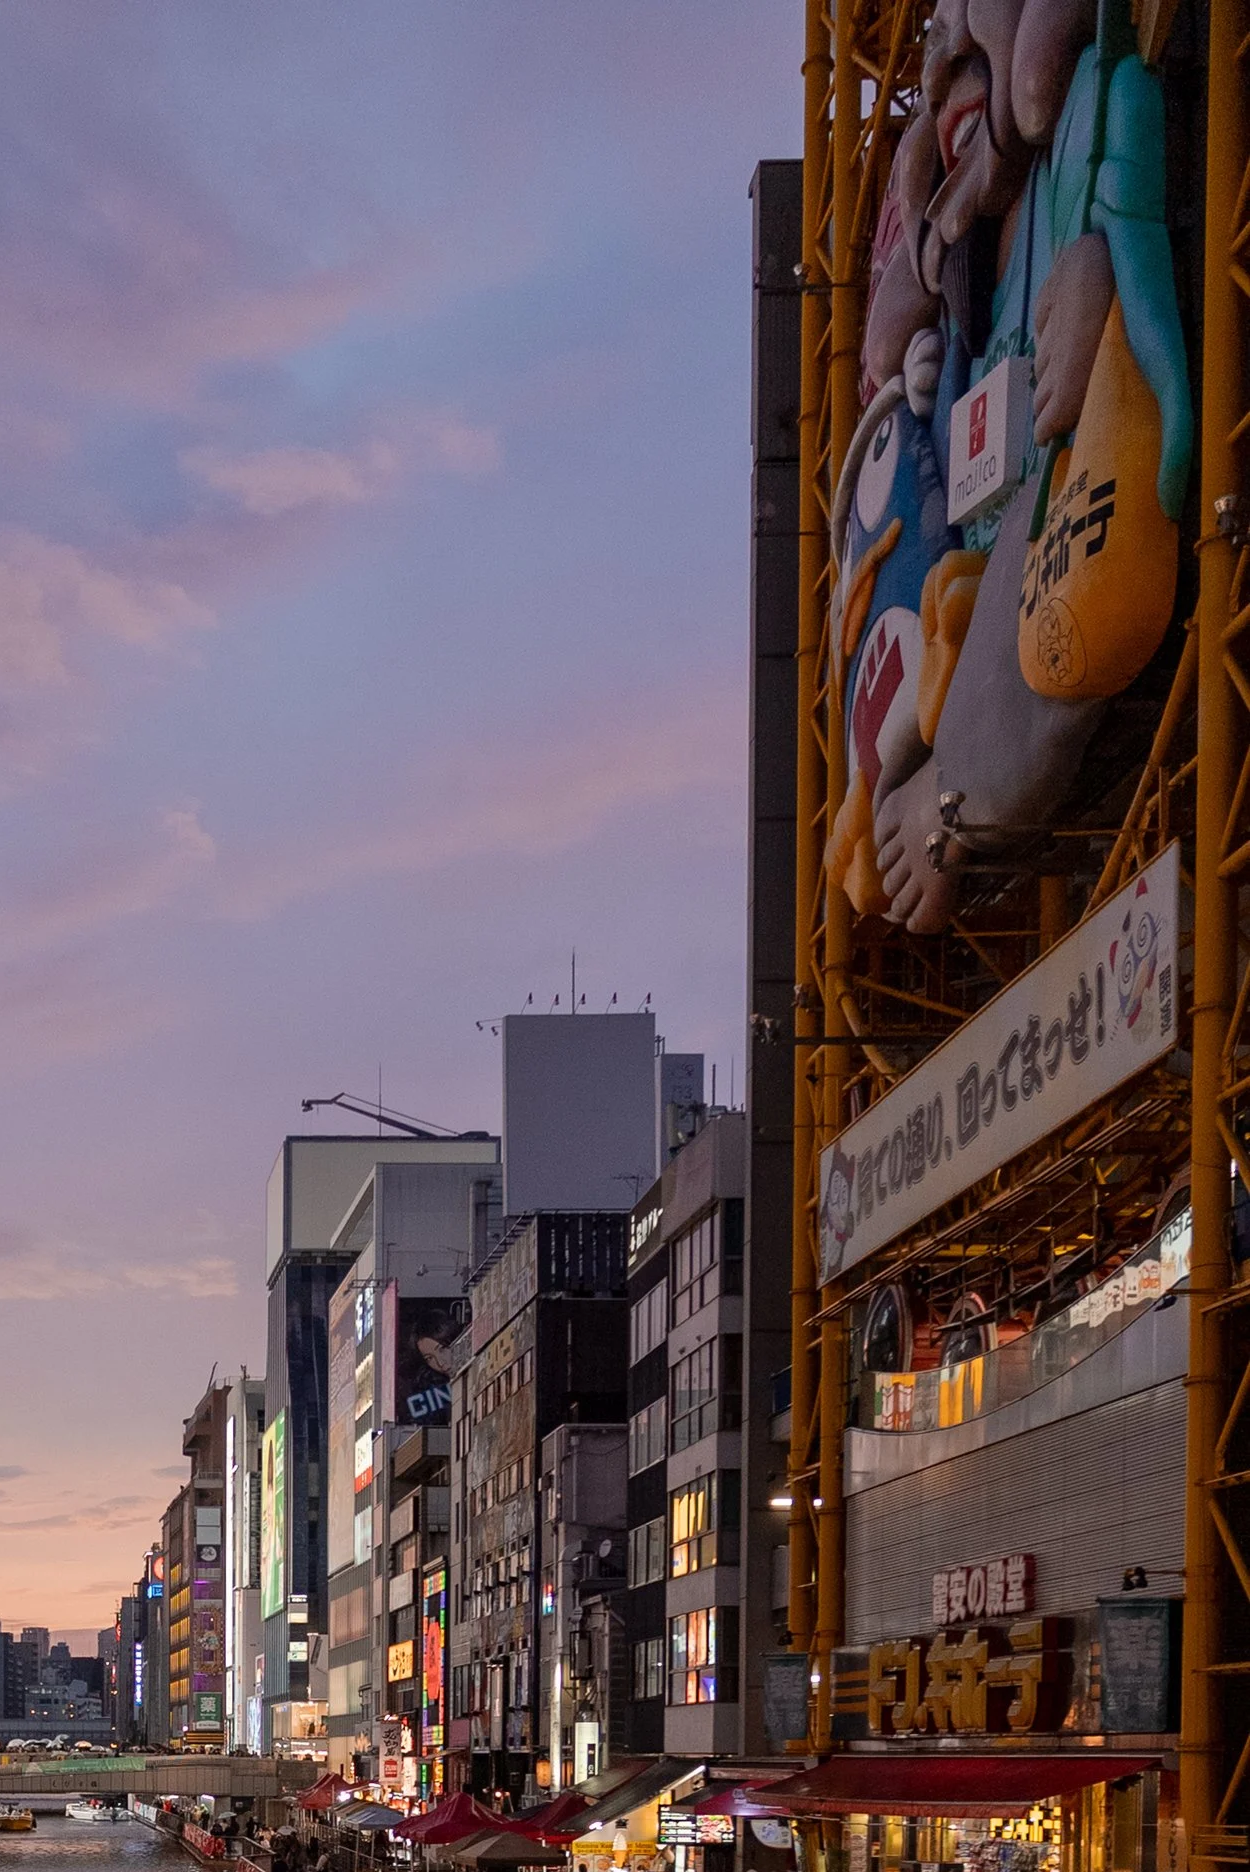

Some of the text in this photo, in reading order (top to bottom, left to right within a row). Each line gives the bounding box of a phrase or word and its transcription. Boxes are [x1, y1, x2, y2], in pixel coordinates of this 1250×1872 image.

[932, 1554, 1027, 1627] 驚安の殿堂
